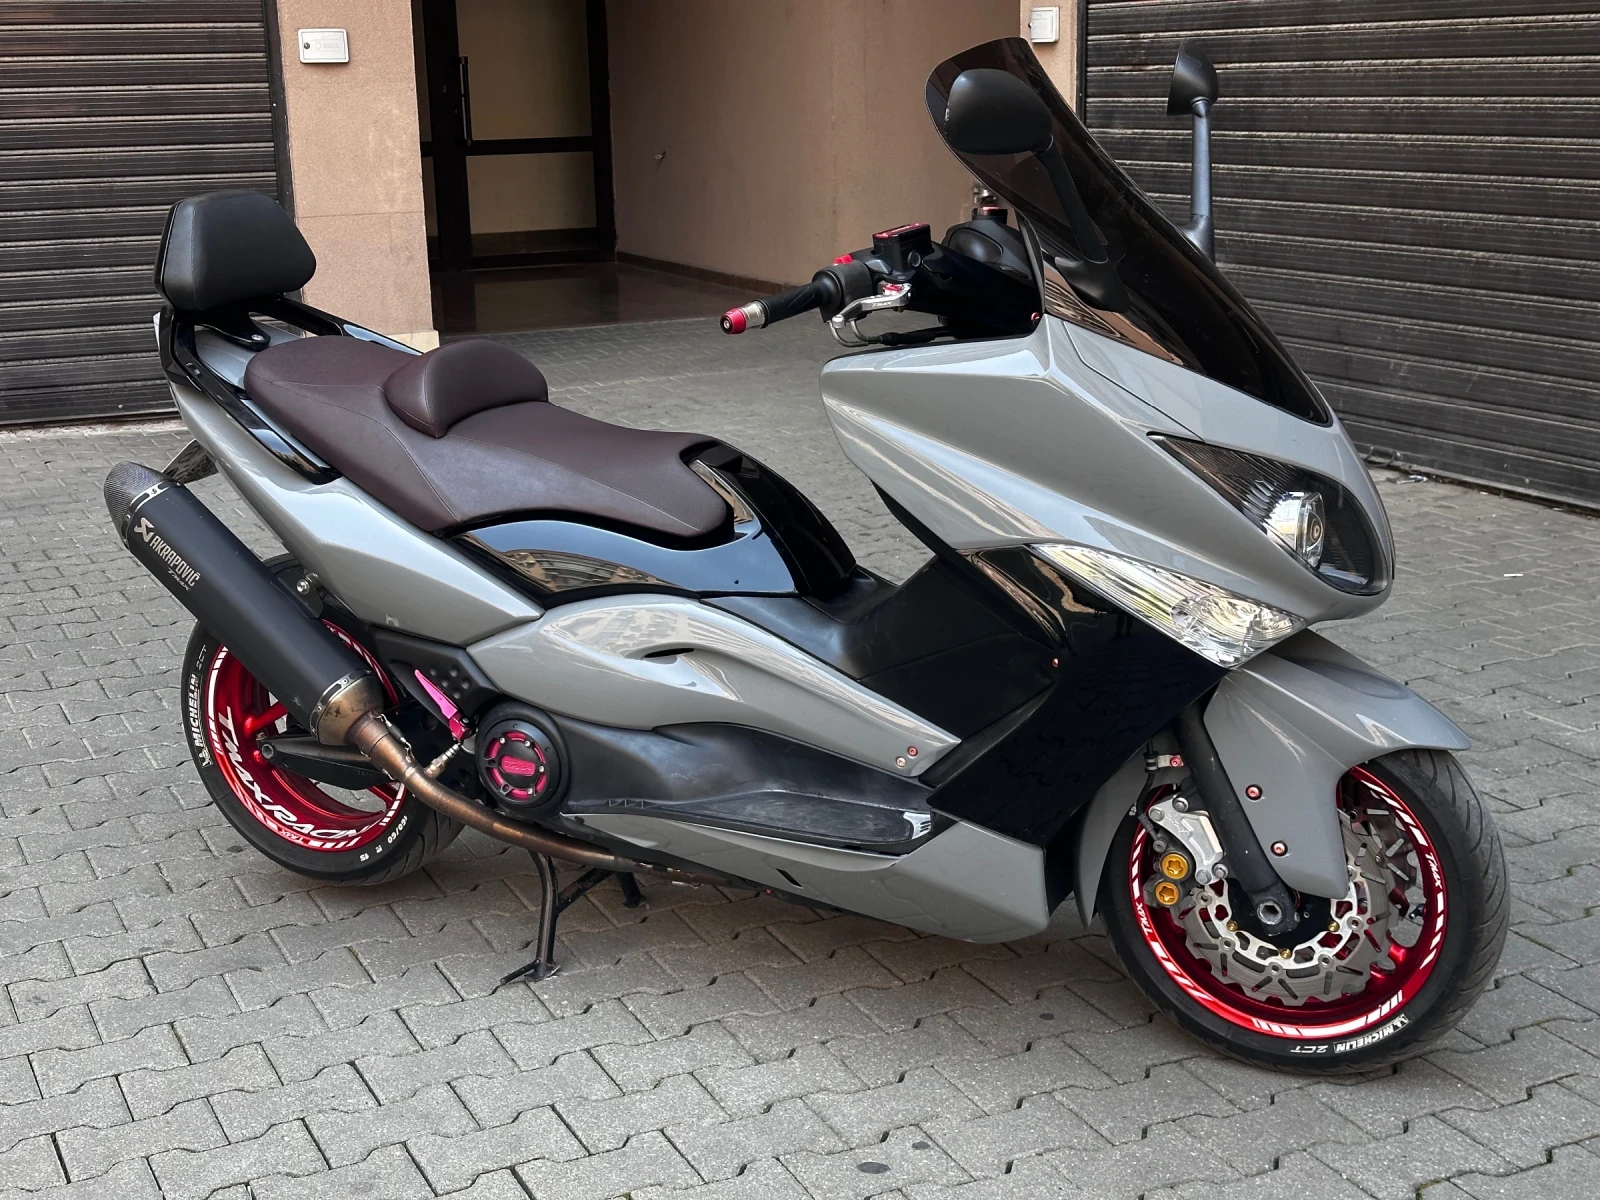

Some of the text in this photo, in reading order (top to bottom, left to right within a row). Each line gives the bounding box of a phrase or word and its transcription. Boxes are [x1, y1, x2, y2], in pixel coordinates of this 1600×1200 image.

[188, 644, 207, 747] MICHELIN 2CT
[1425, 852, 1443, 890] TMAX
[1135, 901, 1154, 936] TMAX
[1290, 1023, 1395, 1054] MICHELIN 2CT
